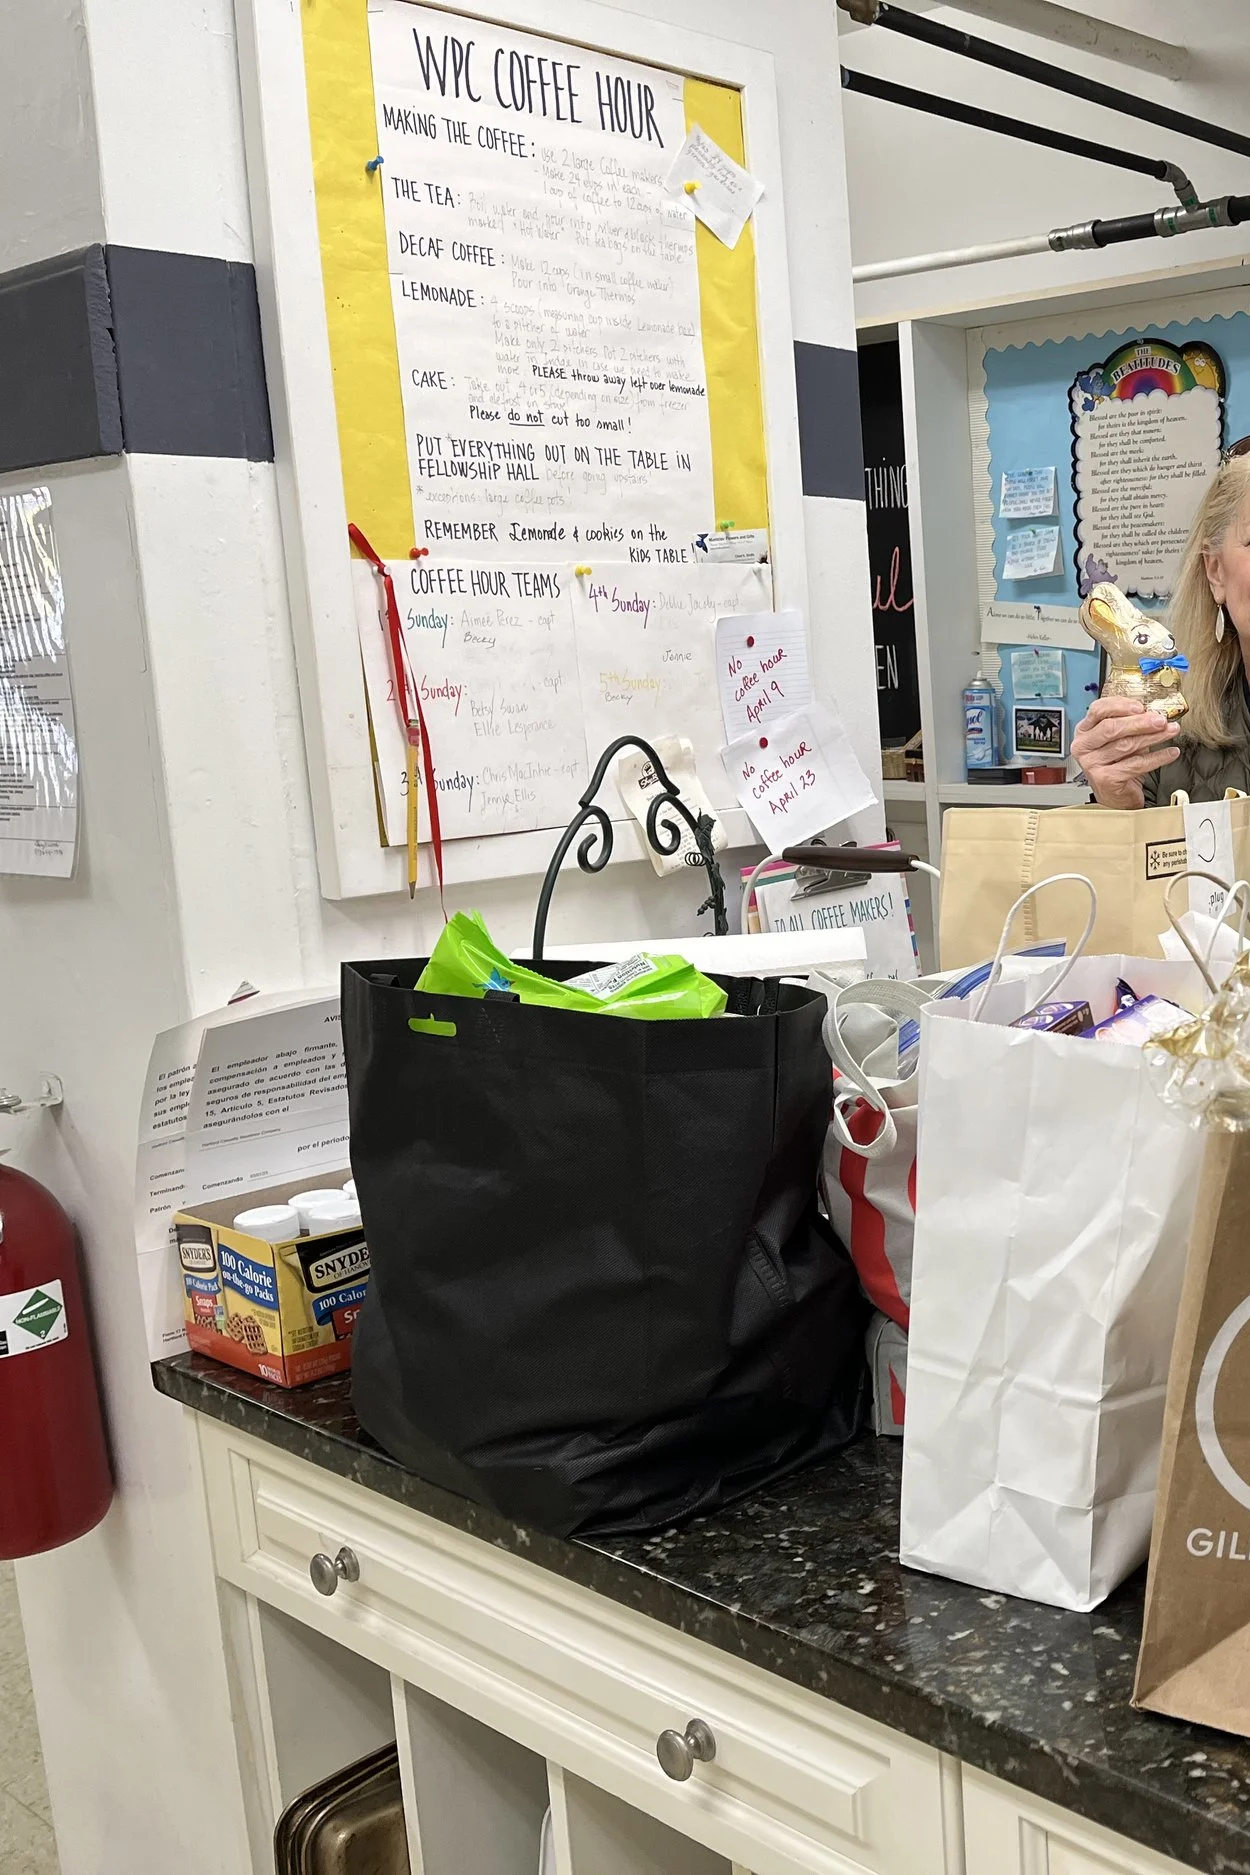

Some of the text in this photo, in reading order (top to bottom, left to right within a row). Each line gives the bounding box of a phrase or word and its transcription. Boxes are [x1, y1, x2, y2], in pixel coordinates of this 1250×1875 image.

[413, 28, 664, 147] WPC COFFEE HOUR
[383, 104, 436, 139] MAKING
[442, 118, 471, 145] THE
[392, 177, 461, 208] THE TEA:
[400, 231, 444, 260] DECAF
[532, 365, 705, 397] PLEASE throw away left over lemonade
[1113, 358, 1180, 382] BEATITUDES
[470, 405, 501, 421] Please
[508, 410, 522, 423] do
[526, 411, 543, 424] not
[551, 413, 569, 427] cut
[576, 415, 591, 429] too
[1128, 411, 1139, 419] poor
[1137, 417, 1159, 426] kingdom
[1160, 416, 1166, 425] of
[1090, 432, 1109, 440] Blessed
[1119, 429, 1130, 438] they
[416, 433, 441, 458] PUT
[451, 437, 535, 462] EVERYTHING
[545, 444, 566, 464] OUT
[574, 446, 590, 464] ON
[594, 447, 622, 467] THE
[627, 449, 668, 471] TABLE
[418, 458, 540, 481] FELLOWSHIP HALL
[1120, 466, 1132, 474] they
[1133, 464, 1148, 473] which
[425, 520, 498, 541] REMEMBER
[586, 522, 624, 542] cookies
[631, 530, 644, 540] on
[649, 524, 667, 541] the
[411, 568, 561, 598] COFFEE HOUR TEAMS
[589, 583, 608, 612] 4th
[728, 655, 743, 677] No
[735, 672, 760, 702] coffee
[771, 680, 785, 698] 9
[742, 761, 756, 781] No
[799, 769, 816, 790] 23
[752, 768, 783, 800] coffee
[1162, 851, 1168, 859] Be
[1168, 850, 1178, 858] sure
[811, 903, 847, 930] COFFEE
[209, 1066, 268, 1084] compensación
[283, 1054, 326, 1068] empleados
[227, 1055, 268, 1070] empleador
[275, 1049, 297, 1060] abajo
[207, 1081, 250, 1096] asegurado
[254, 1077, 265, 1085] de
[269, 1070, 302, 1082] acuerdo
[324, 1063, 336, 1071] las
[268, 1091, 306, 1105] Estatutos
[203, 1110, 263, 1129] asegurándolos
[202, 1176, 244, 1190] Comenzando
[220, 1250, 273, 1288] 100 Calorie
[222, 1269, 274, 1302] on-the-go Packs
[196, 1295, 214, 1308] Snaps
[319, 1297, 336, 1311] 100
[258, 1363, 268, 1377] 10
